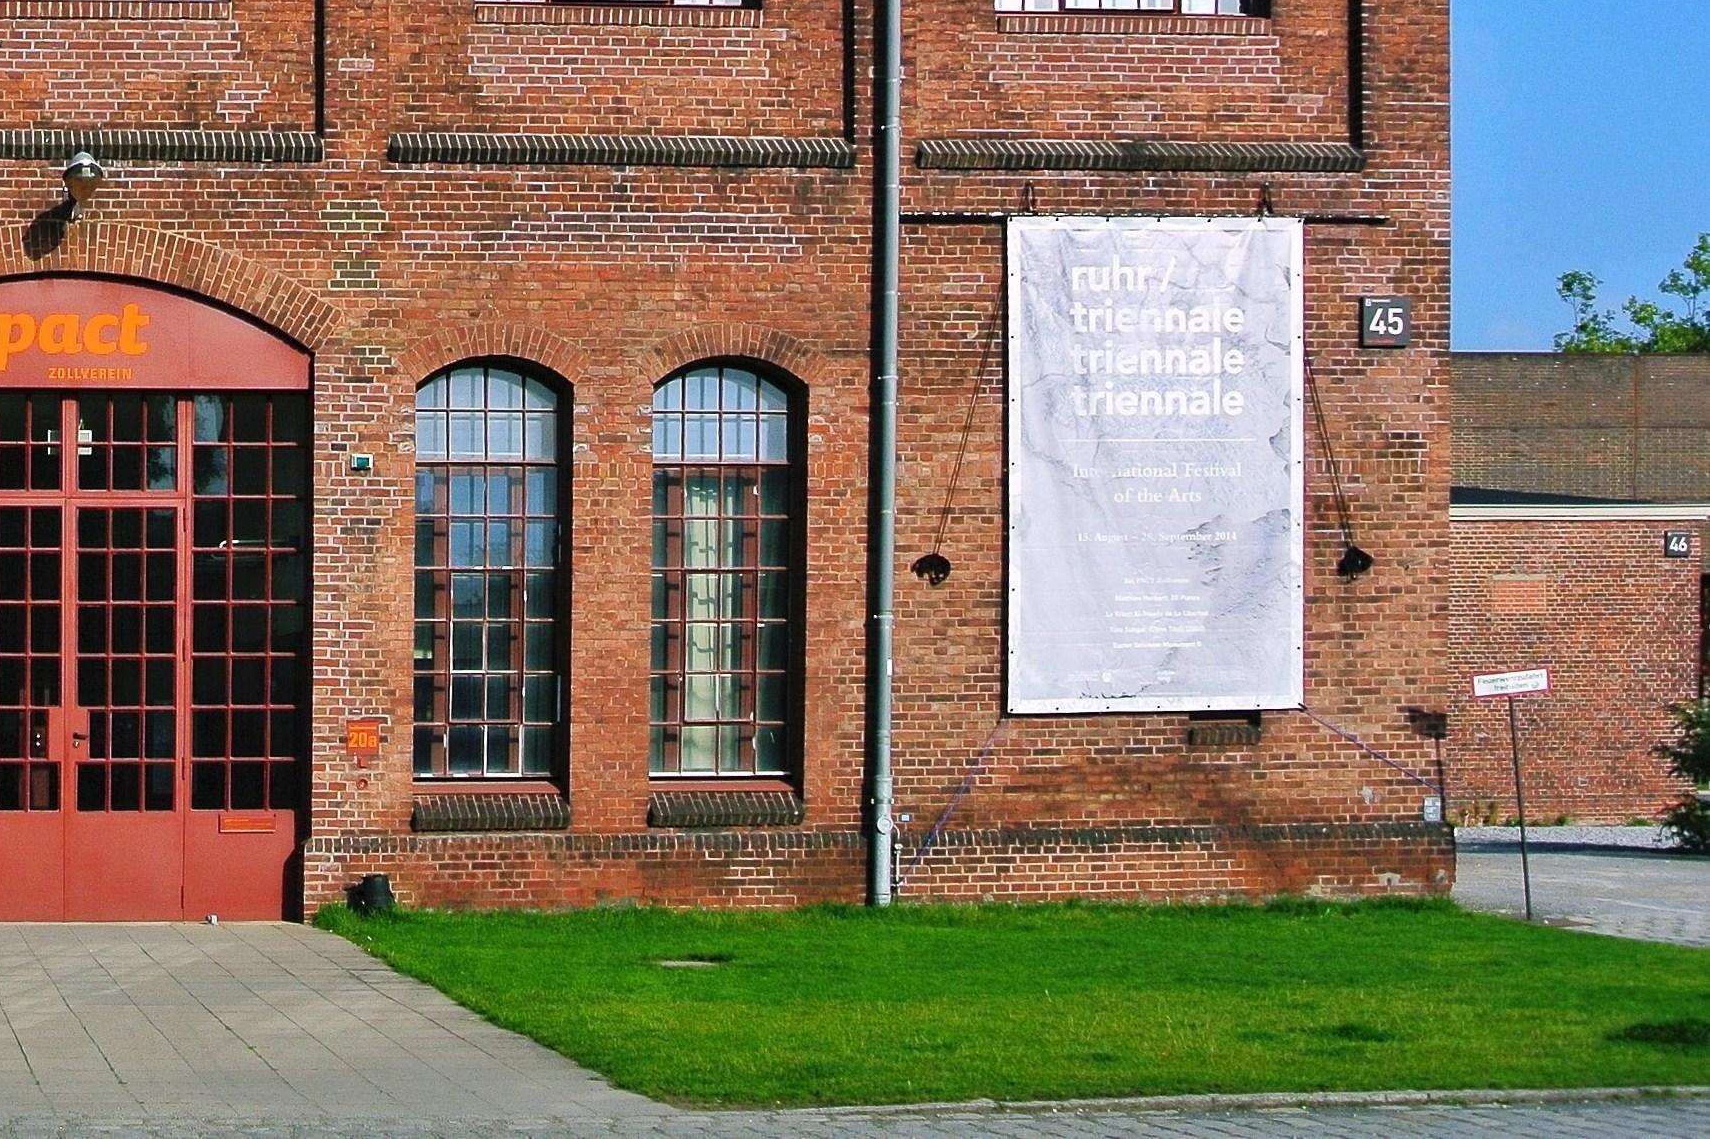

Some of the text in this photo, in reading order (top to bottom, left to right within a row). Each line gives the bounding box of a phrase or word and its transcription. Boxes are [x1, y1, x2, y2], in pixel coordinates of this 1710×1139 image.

[1069, 296, 1245, 333] triennale
[1369, 307, 1404, 335] 45
[1069, 336, 1245, 374] triennale
[48, 367, 132, 380] ZOLLVEREIN
[1069, 377, 1245, 416] triennale
[1073, 462, 1243, 478] Intnational Festival
[1113, 487, 1202, 503] of the Arts
[1214, 531, 1237, 541] 2014
[1669, 536, 1688, 552] 46
[348, 732, 378, 748] 20a
